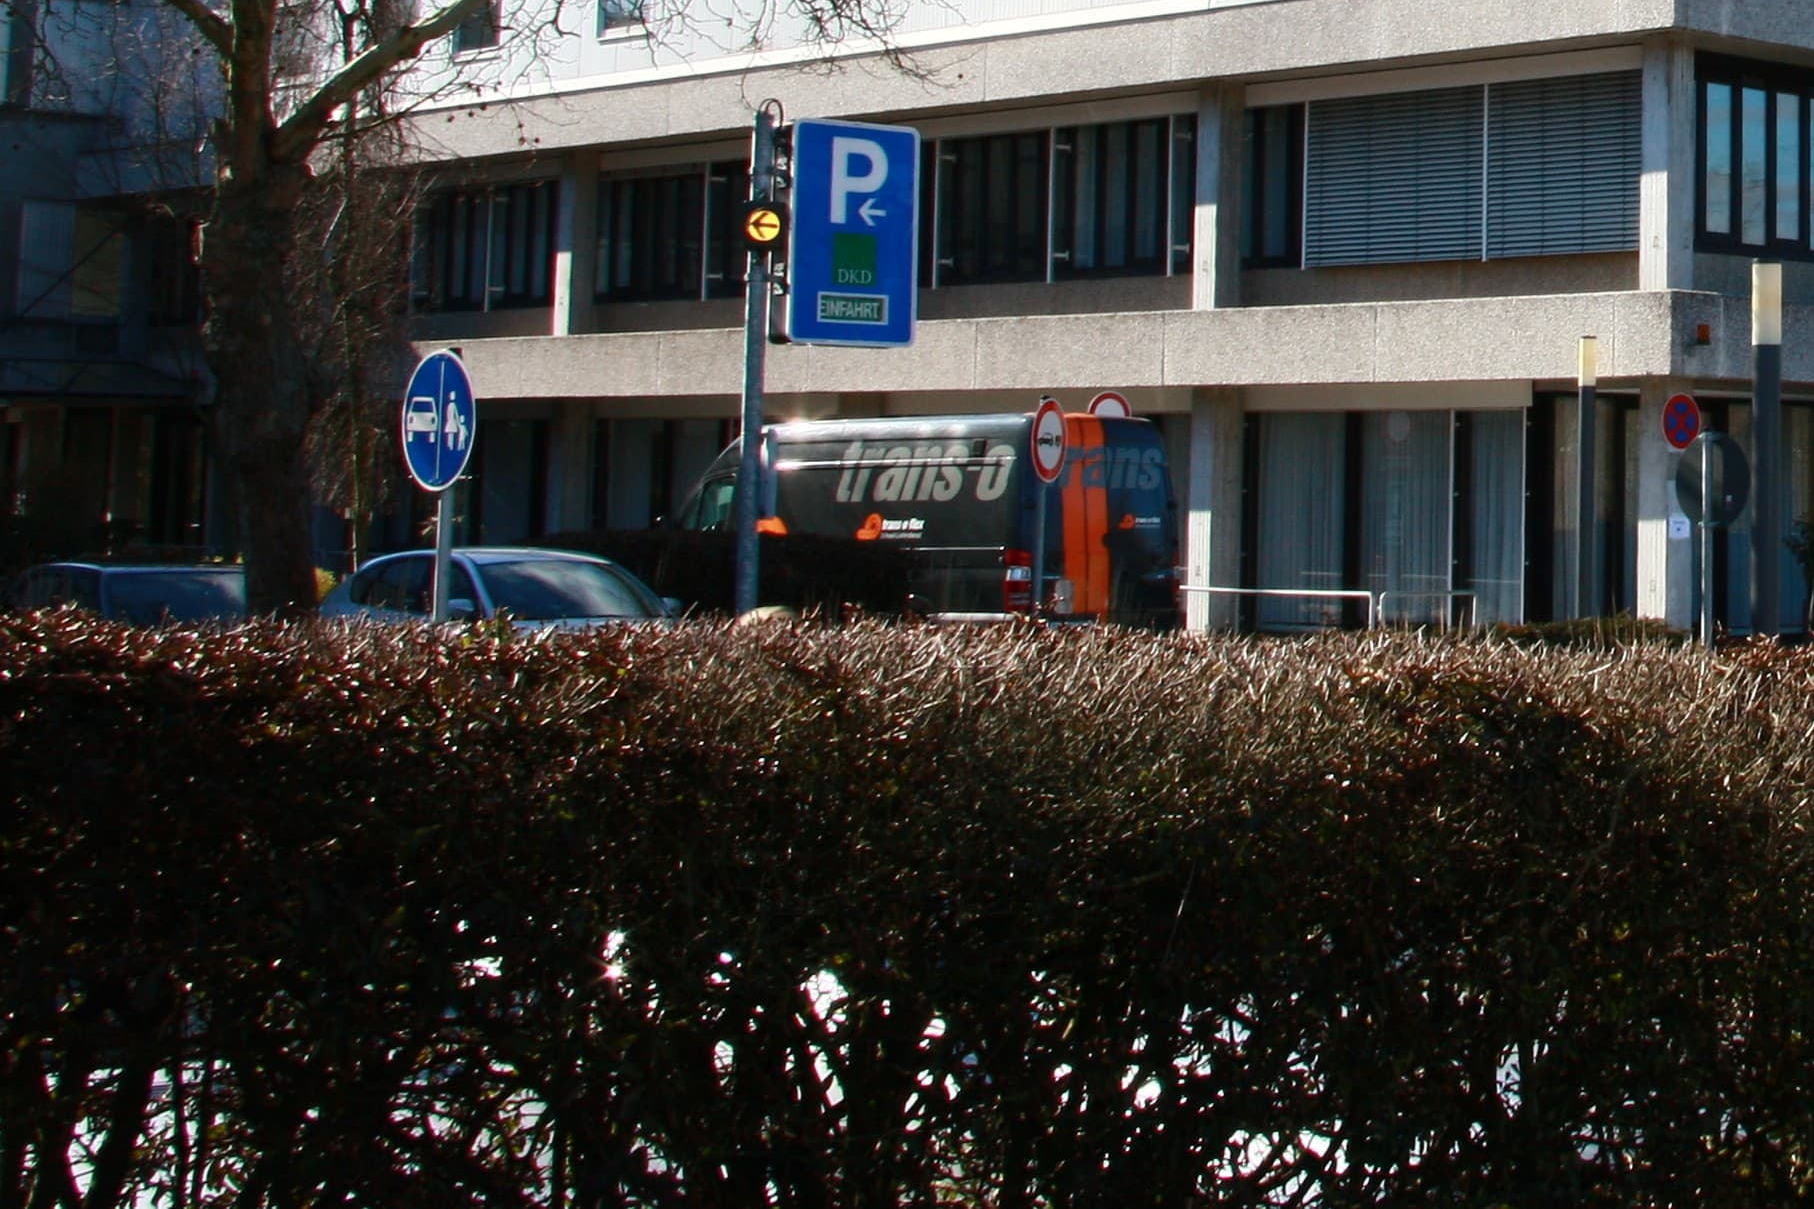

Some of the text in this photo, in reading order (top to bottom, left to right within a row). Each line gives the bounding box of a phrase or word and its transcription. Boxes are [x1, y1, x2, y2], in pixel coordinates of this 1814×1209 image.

[830, 136, 889, 224] P
[837, 269, 872, 284] DKD
[820, 299, 881, 319] EINFAHRT
[1058, 446, 1164, 490] rans
